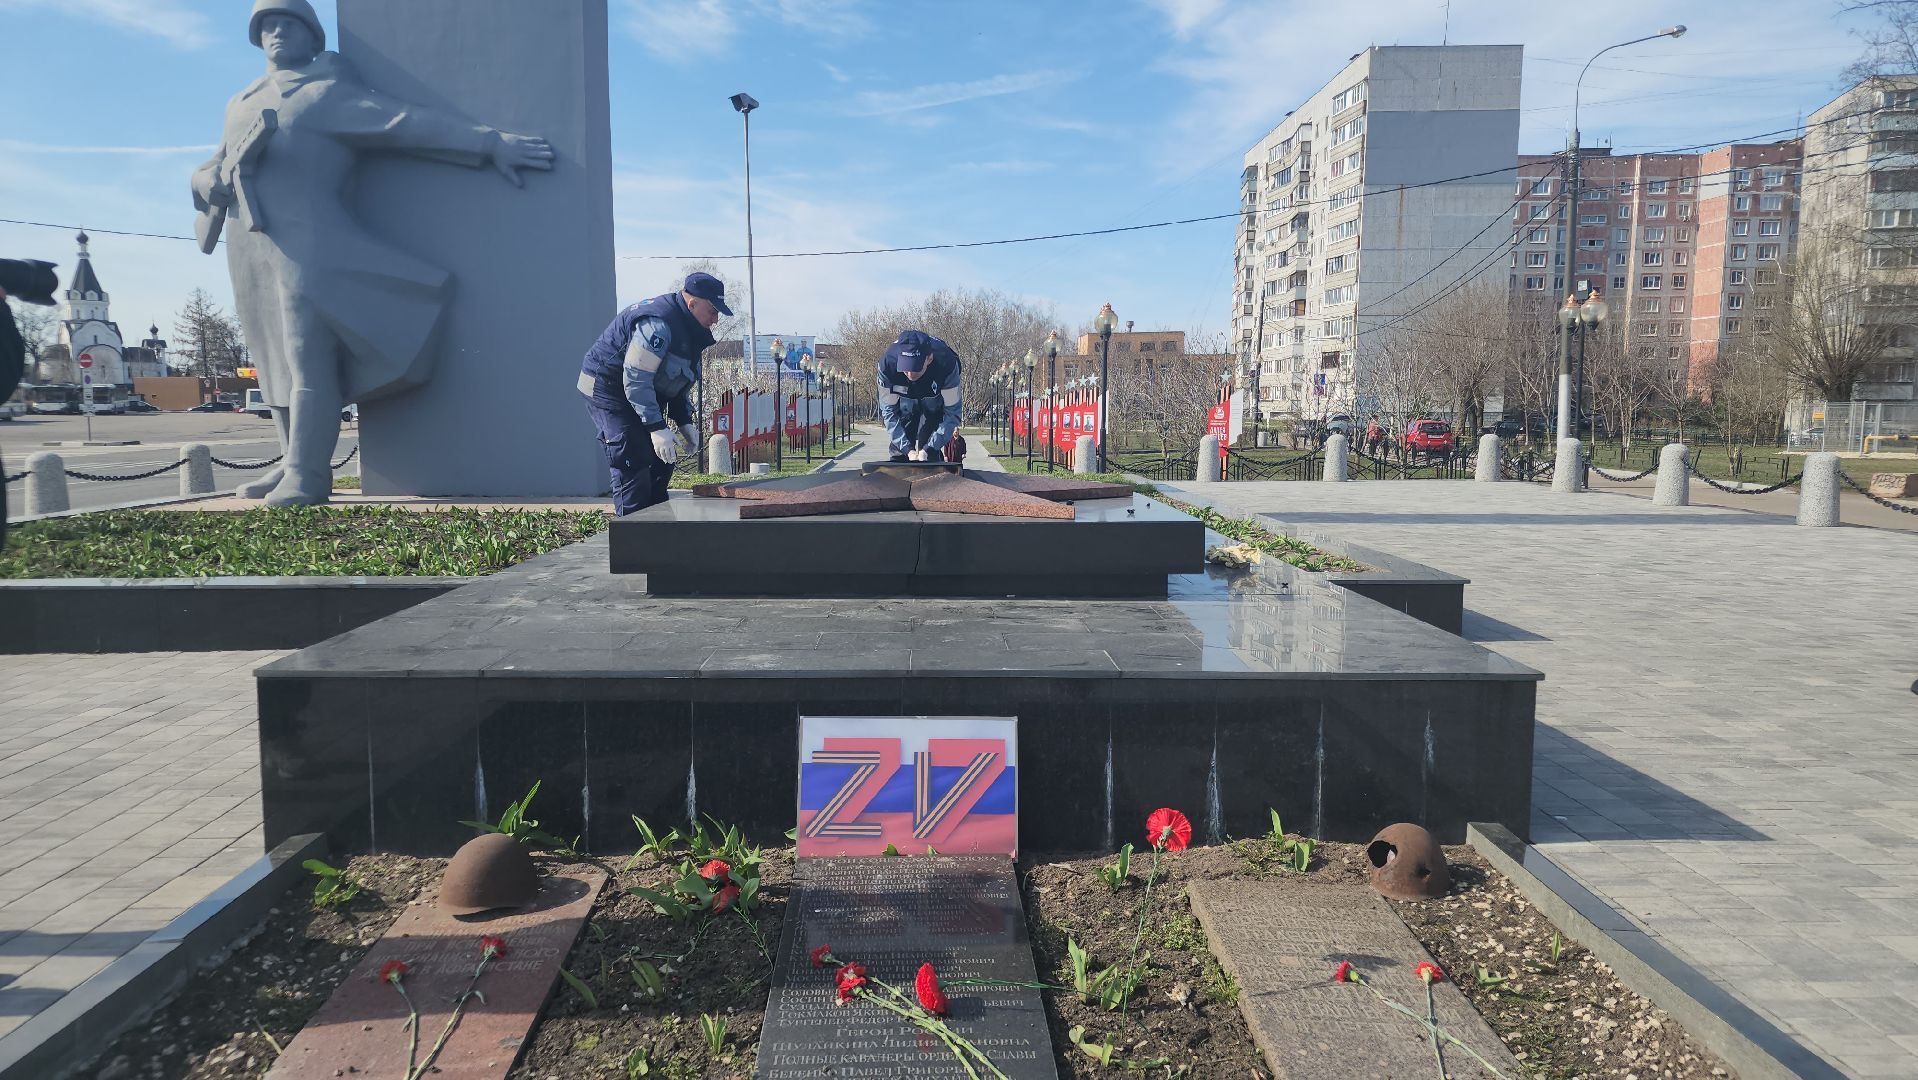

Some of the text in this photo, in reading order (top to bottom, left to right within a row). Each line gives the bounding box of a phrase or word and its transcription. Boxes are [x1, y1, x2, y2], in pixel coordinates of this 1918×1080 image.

[836, 1026, 974, 1037] ГЕРОИ РОСИИ
[772, 1054, 837, 1066] ПОЛНЫЕ
[840, 1053, 915, 1064] КАВАЛЕРЫ
[985, 1049, 1037, 1060] СЛАВЫ
[840, 1066, 893, 1077] ПАВЕЛ
